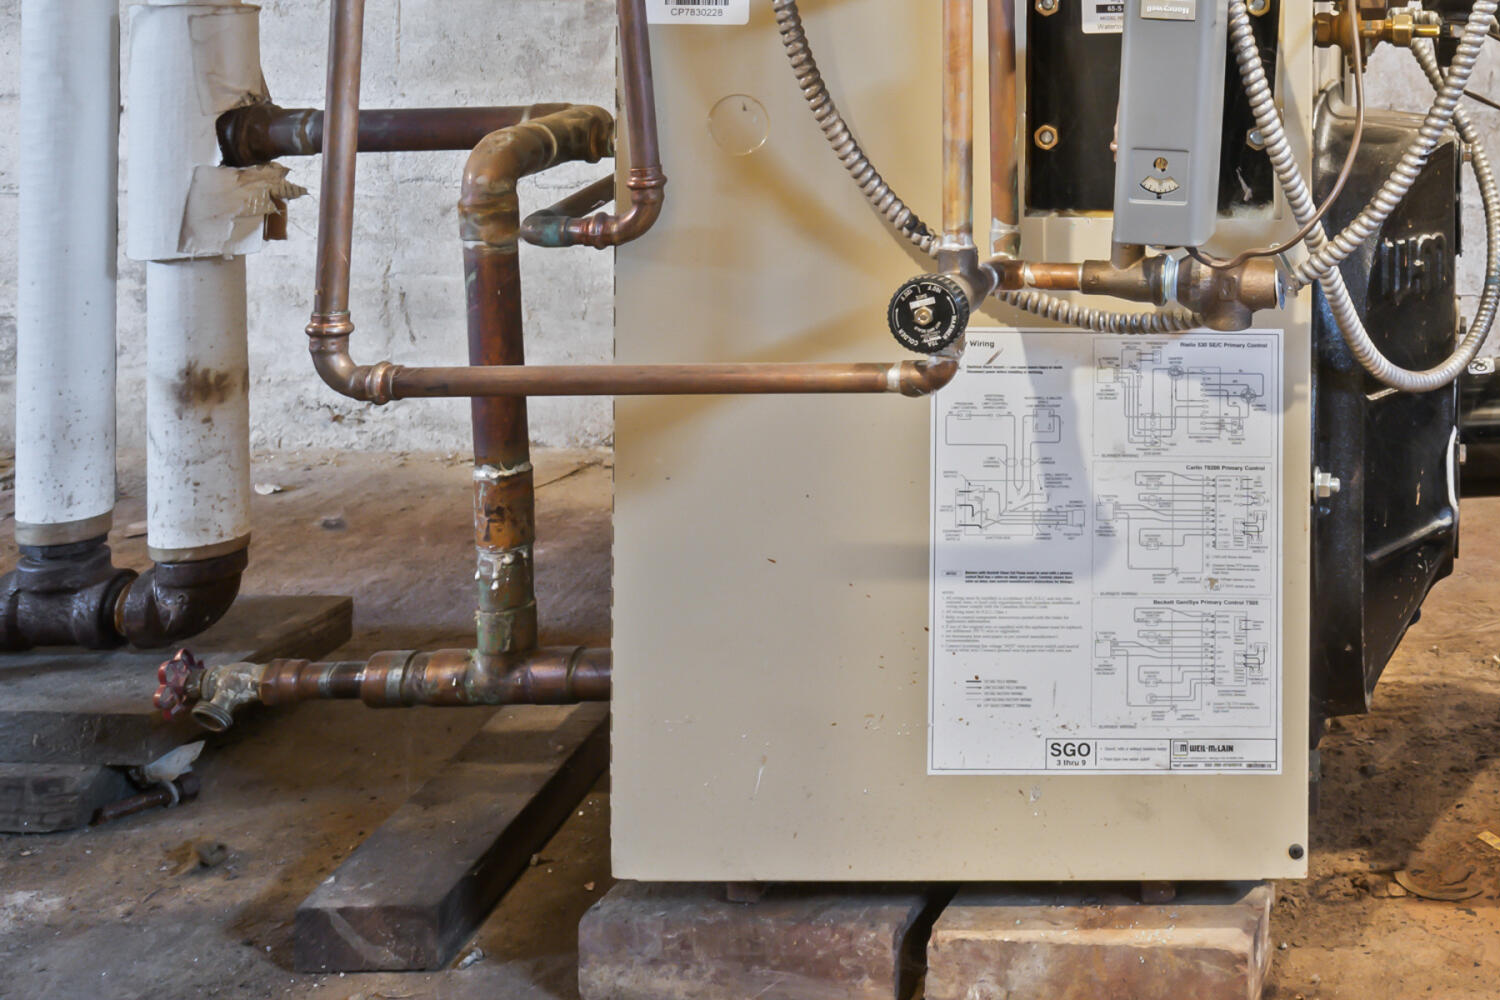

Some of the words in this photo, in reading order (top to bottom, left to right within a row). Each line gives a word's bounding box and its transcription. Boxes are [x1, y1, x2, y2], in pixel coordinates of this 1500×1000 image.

[898, 328, 919, 347] COLDER
[969, 340, 995, 349] Wiring
[1049, 742, 1091, 757] SGO
[1056, 759, 1061, 767] 3
